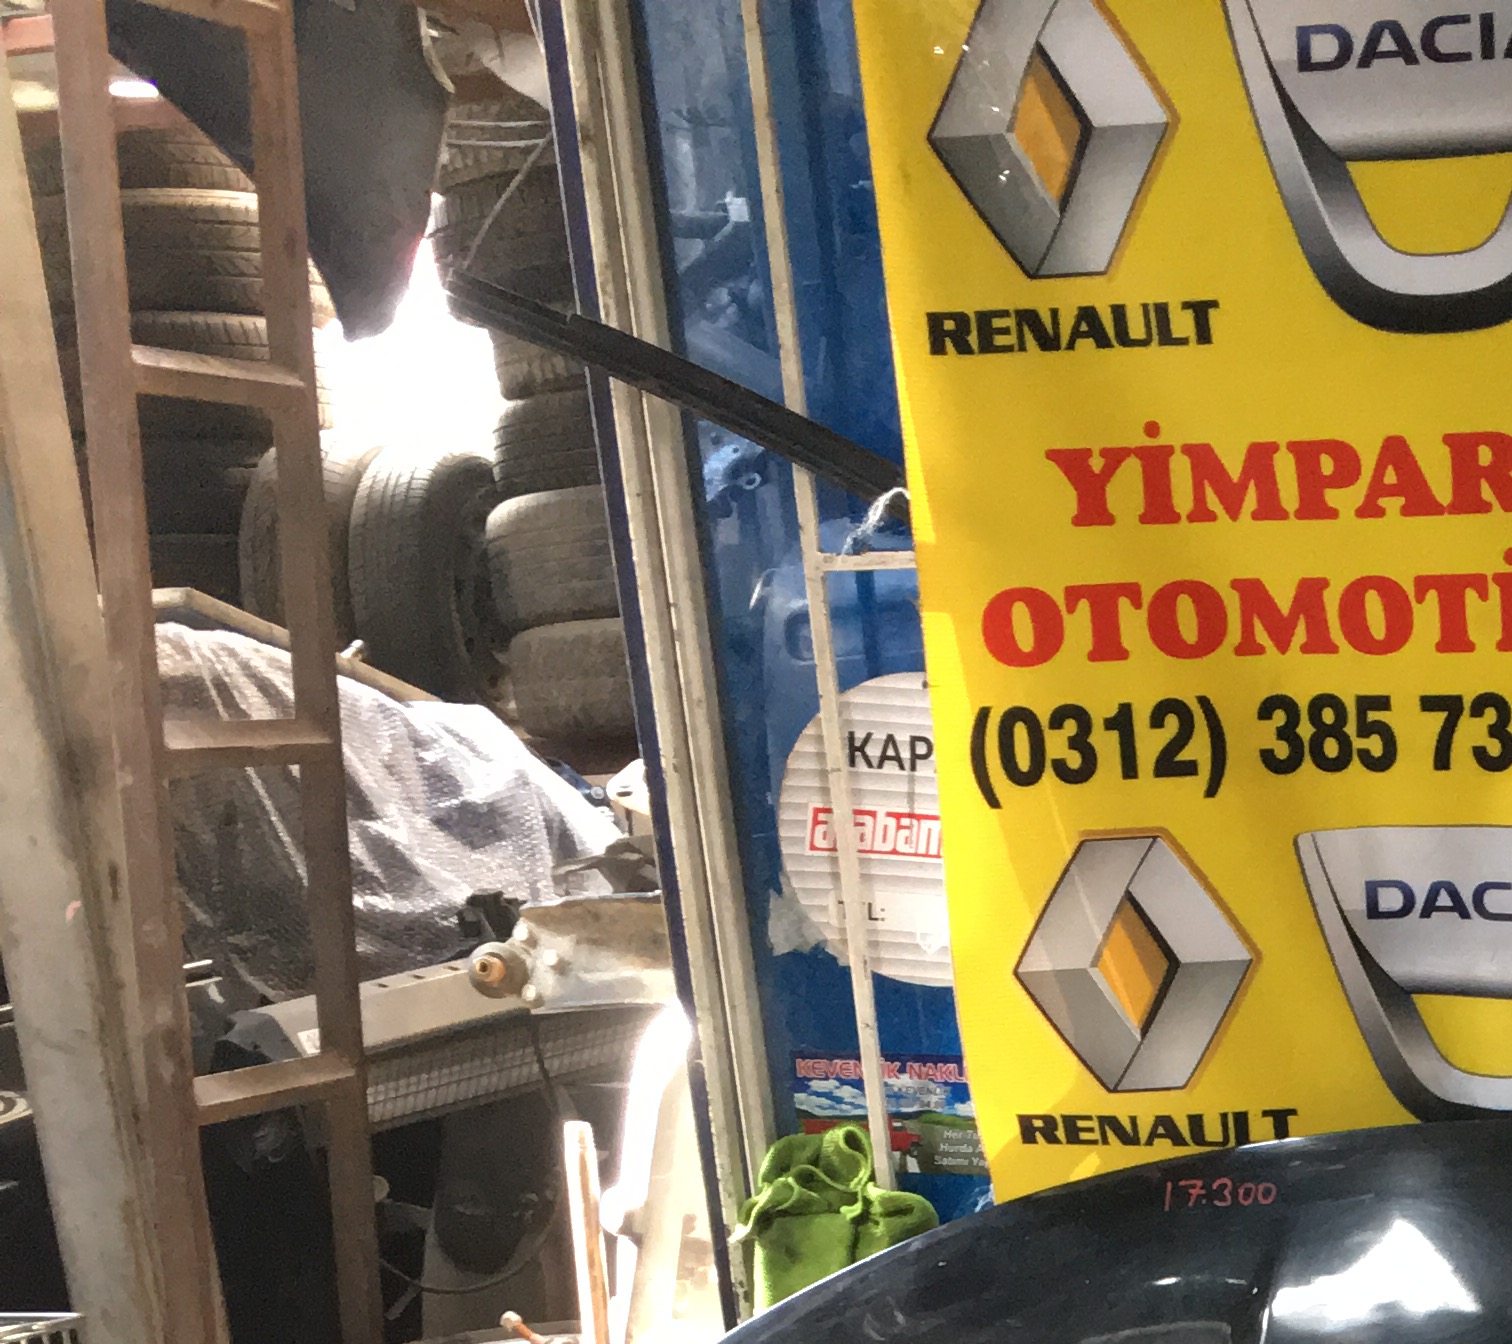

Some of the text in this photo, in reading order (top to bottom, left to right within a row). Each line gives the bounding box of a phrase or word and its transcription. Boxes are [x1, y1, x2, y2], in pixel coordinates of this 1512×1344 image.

[926, 299, 1220, 356] RENAULT
[847, 731, 938, 773] KAP
[970, 695, 1228, 809] (0312)
[1256, 693, 1398, 776] 385
[796, 1058, 967, 1083] KEVENİK NAKL
[1164, 1177, 1277, 1211] 17.300
